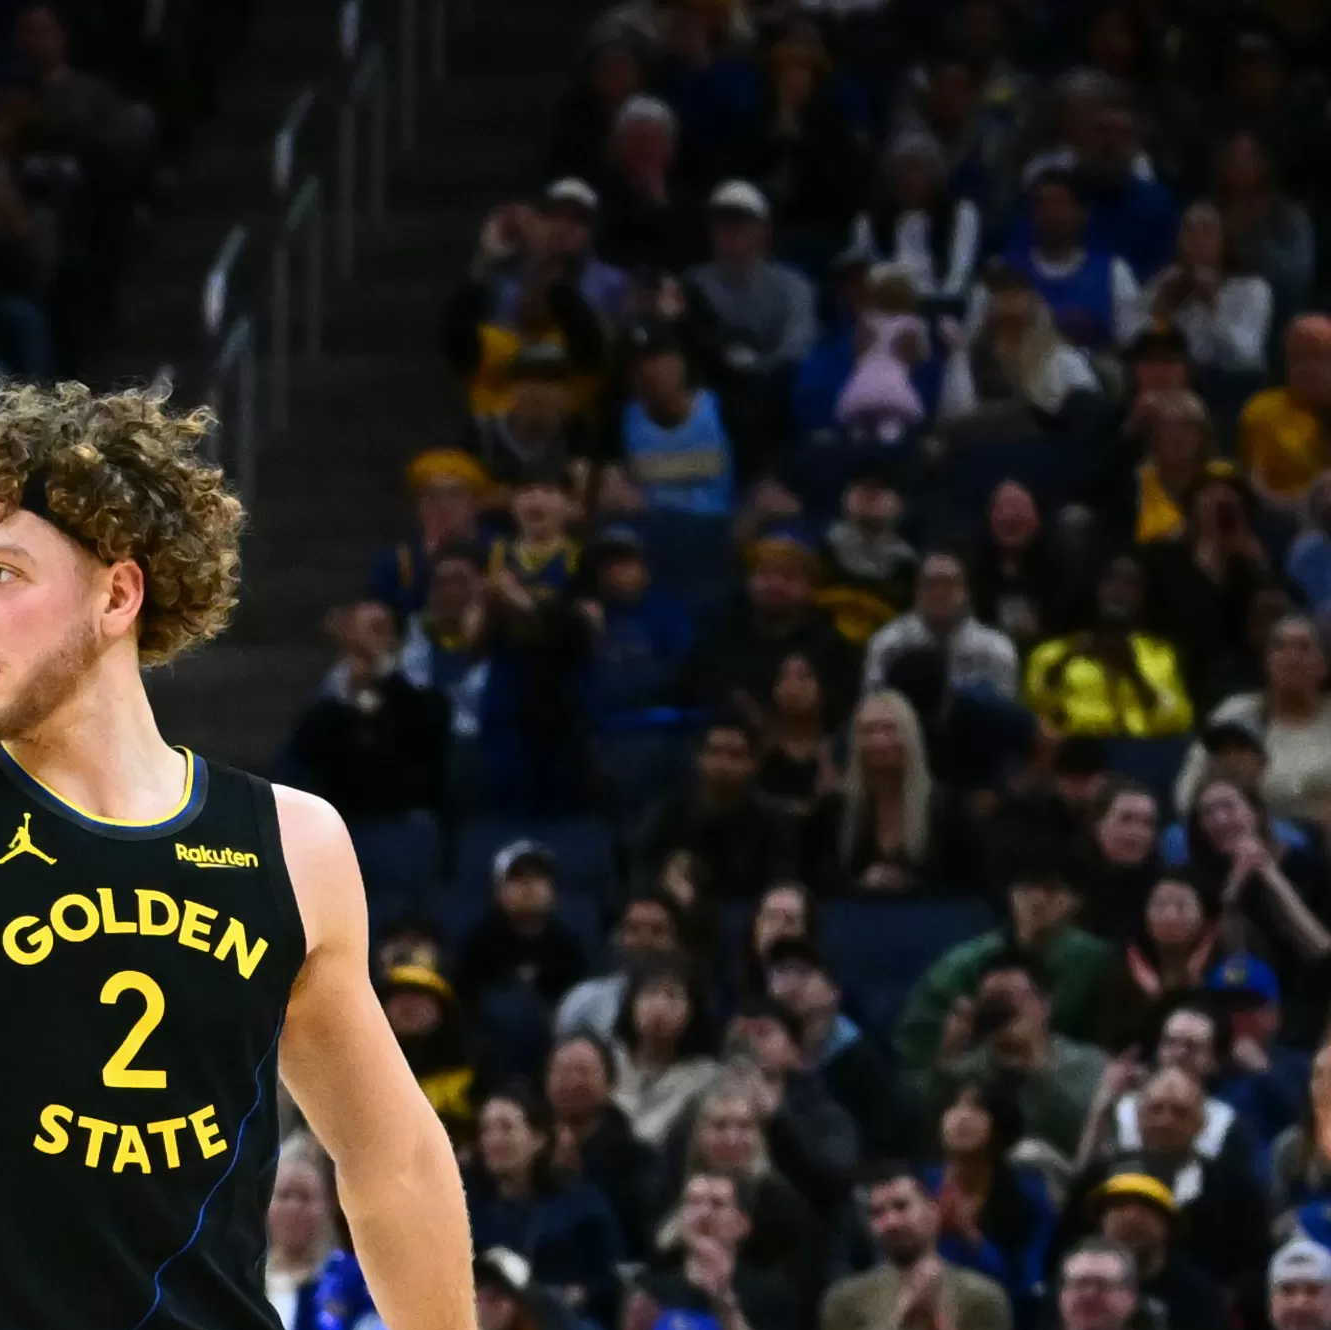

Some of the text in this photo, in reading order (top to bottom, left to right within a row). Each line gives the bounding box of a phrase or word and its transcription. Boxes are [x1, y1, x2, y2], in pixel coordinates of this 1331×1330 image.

[175, 843, 259, 868] Rakuten
[2, 887, 269, 980] GOLDEN
[99, 970, 167, 1089] 2
[33, 1103, 228, 1174] STATE
